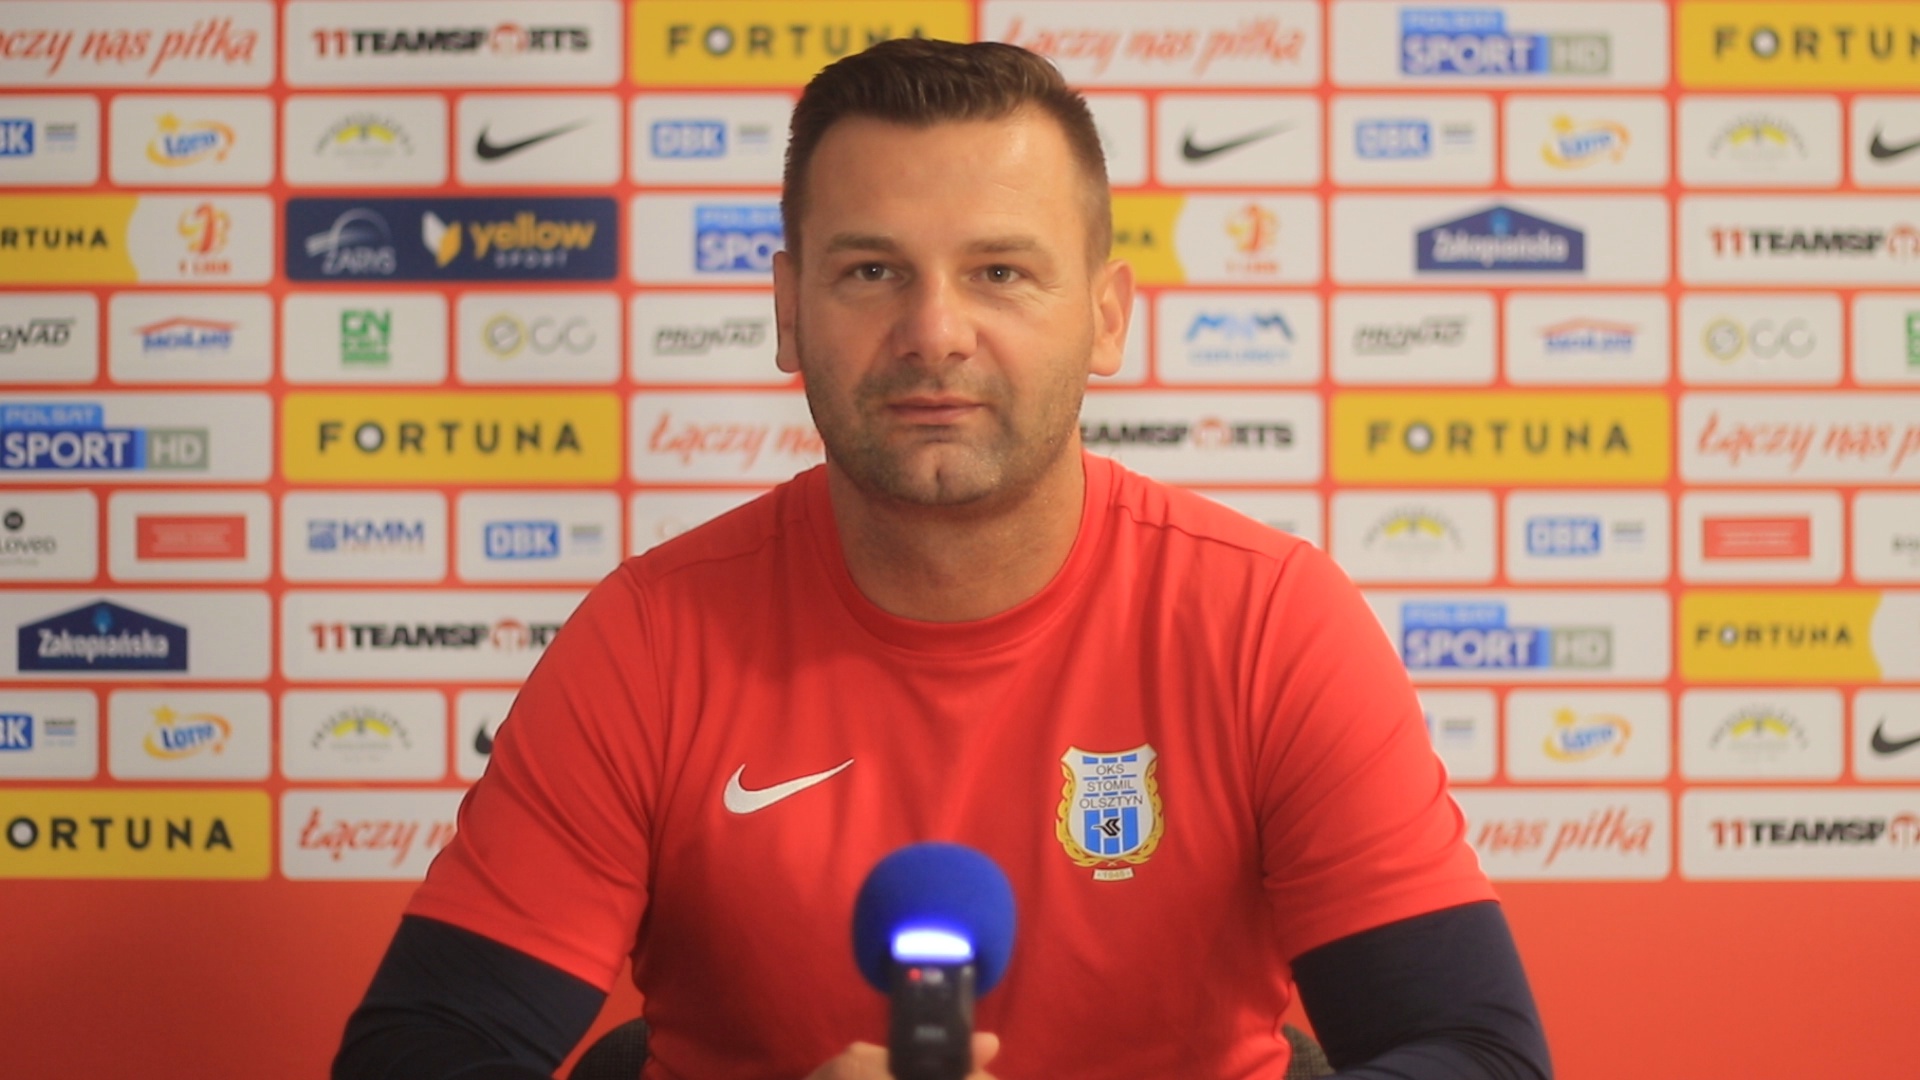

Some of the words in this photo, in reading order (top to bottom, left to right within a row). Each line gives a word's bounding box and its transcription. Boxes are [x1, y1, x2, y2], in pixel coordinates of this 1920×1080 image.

[0, 29, 72, 77] czy
[81, 29, 149, 63] nas
[149, 17, 259, 79] piłka
[313, 23, 591, 57] 11TEAMSPORTS
[1197, 16, 1304, 76] piłka
[1402, 35, 1534, 73] SPORT
[1714, 25, 1920, 59] FORTU
[657, 123, 723, 156] DBK
[0, 227, 109, 249] RTUNA
[470, 213, 597, 259] yellow
[700, 232, 785, 268] SPO
[1709, 226, 1920, 258] 11TEAMSPO
[4, 432, 129, 467] SPORT
[153, 433, 202, 465] HD
[319, 421, 583, 454] FORTUNA
[649, 413, 768, 470] Łączy
[1080, 418, 1292, 447] EAMSPORTS
[1368, 421, 1631, 455] FORTUNA
[1697, 413, 1814, 470] Łączy
[1822, 424, 1889, 460] nas
[342, 521, 425, 542] KMM
[490, 524, 556, 555] DBK
[38, 628, 169, 663] Zakopiańska
[1405, 629, 1534, 666] SPORT
[1696, 621, 1852, 646] FORTUNA
[1087, 780, 1134, 792] STOMIL
[1096, 763, 1125, 775] OKS
[1079, 795, 1143, 809] OLSZTYN
[6, 817, 234, 851] ORTUNA
[300, 806, 419, 868] Łączy
[1477, 820, 1545, 857] nas
[1544, 808, 1654, 868] piłka
[1711, 816, 1920, 849] 11TEAMSPO
